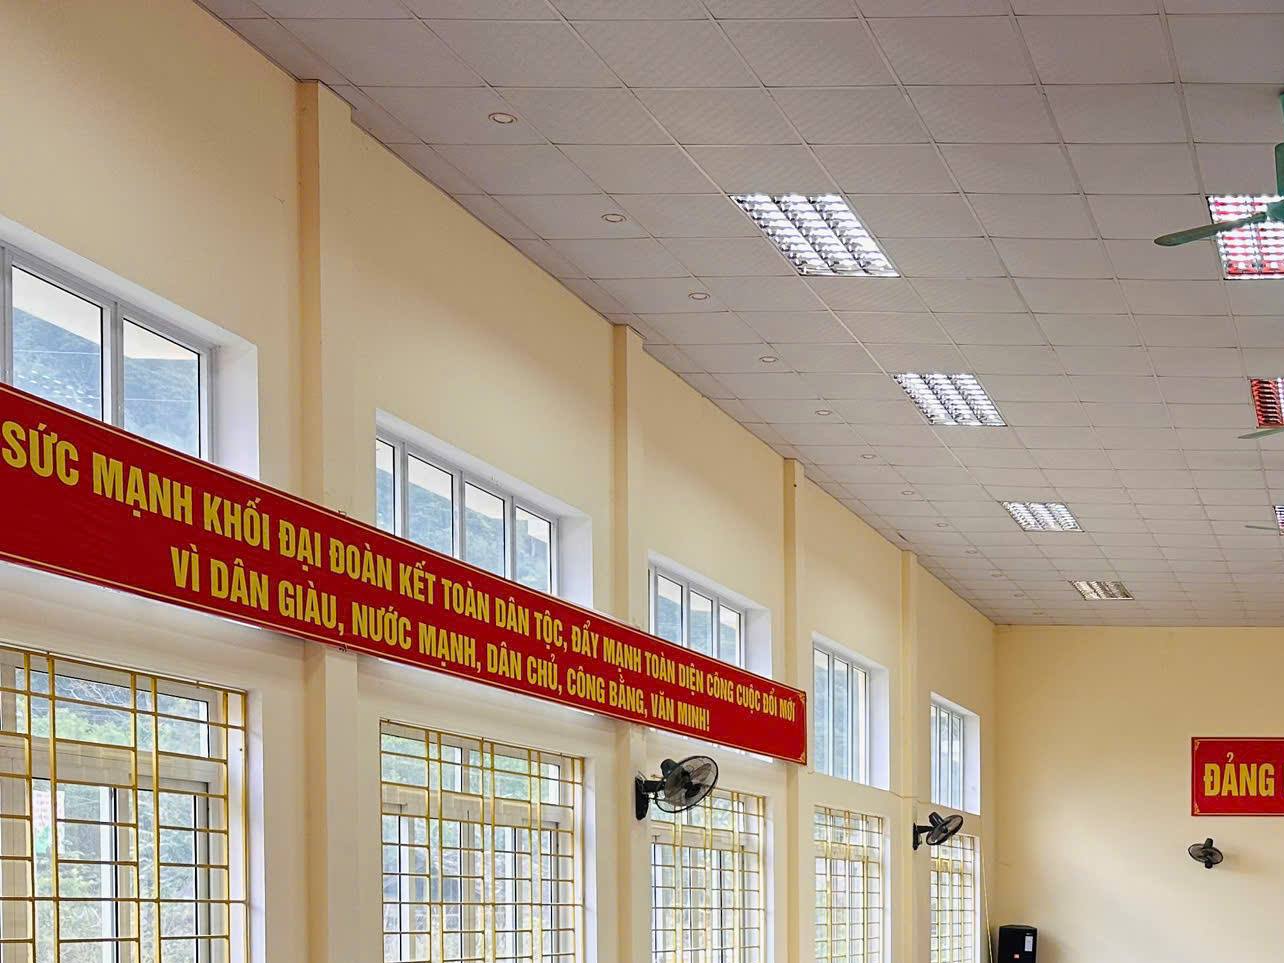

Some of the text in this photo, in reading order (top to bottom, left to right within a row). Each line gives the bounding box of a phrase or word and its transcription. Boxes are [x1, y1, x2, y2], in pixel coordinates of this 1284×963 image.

[1, 420, 79, 486] SỨC
[93, 452, 193, 525] MẠNH
[203, 492, 270, 551] KHỐI
[278, 519, 321, 571] ĐẠI
[329, 537, 392, 591] ĐOÀN
[400, 560, 435, 605] KẾT
[441, 577, 490, 624] TOÀN
[495, 597, 530, 637] DÂN
[534, 609, 568, 653] TỘC,
[571, 619, 600, 660] ĐẨY
[603, 636, 642, 673] MẠNH
[644, 651, 676, 686] TOÀN
[678, 664, 704, 697] DIỆN
[706, 671, 734, 702] CÔNG
[736, 684, 761, 714] CUỘC
[762, 688, 778, 717] ĐỔI
[170, 543, 710, 732] VÌ DÂN GIÀU, NƯỚC MẠNH, DÂN CHỦ, CÔNG BẰNG, VĂN MINH!
[1203, 752, 1275, 797] ĐẢNG
